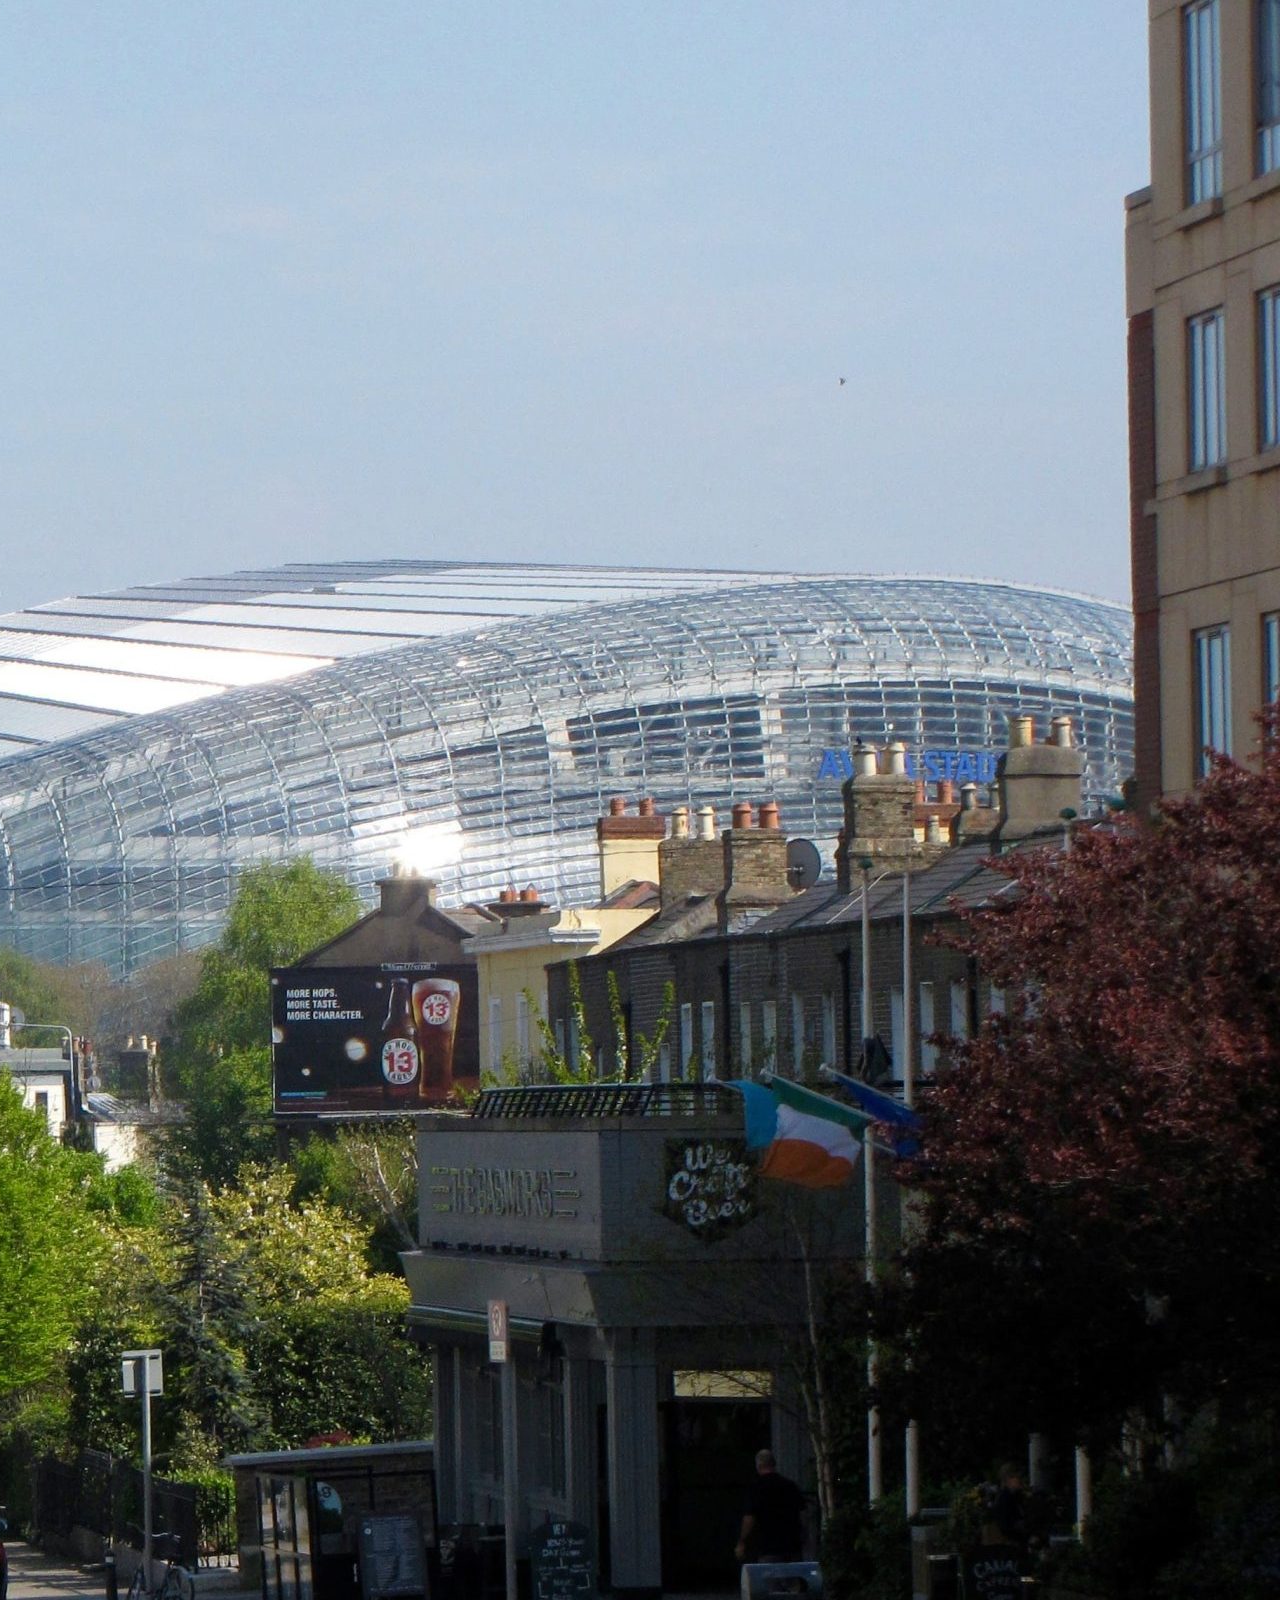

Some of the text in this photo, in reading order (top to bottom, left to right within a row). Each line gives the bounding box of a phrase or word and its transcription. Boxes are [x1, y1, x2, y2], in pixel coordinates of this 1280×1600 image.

[818, 751, 920, 781] AVA
[286, 988, 338, 998] MORE HOPS.
[286, 999, 341, 1009] MORE TASTE.
[429, 1003, 447, 1016] 13
[286, 1010, 365, 1020] MORE CHARACTER.
[388, 1051, 413, 1072] 13
